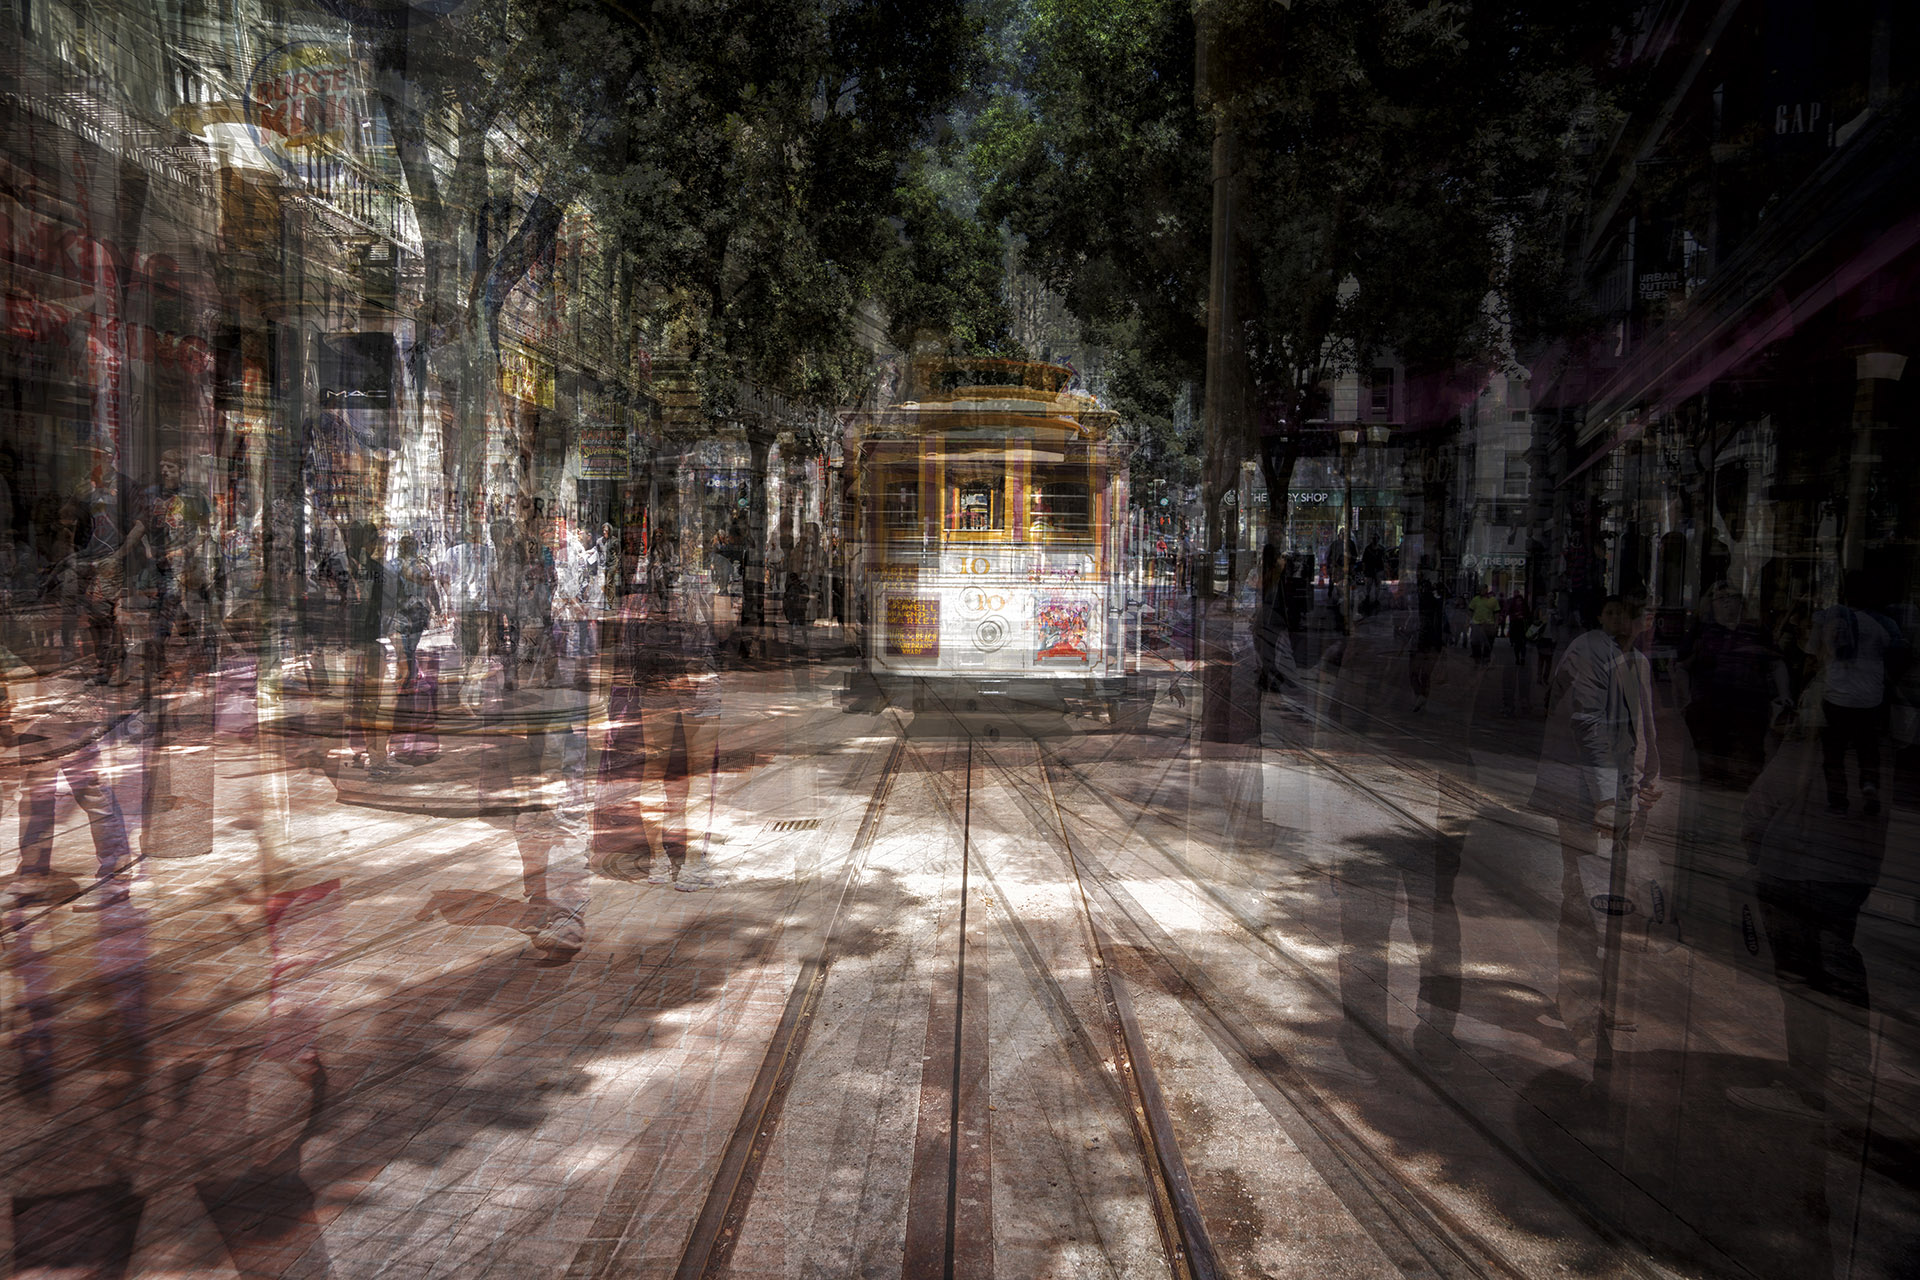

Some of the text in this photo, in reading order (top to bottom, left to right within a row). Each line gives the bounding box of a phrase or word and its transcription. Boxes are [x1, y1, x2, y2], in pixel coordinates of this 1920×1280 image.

[256, 69, 348, 106] BURGE
[1775, 102, 1822, 135] GAP
[1639, 272, 1678, 283] URBAN
[1300, 493, 1329, 503] SHOP
[959, 557, 991, 575] 10
[1483, 556, 1526, 567] THE BOD
[977, 594, 1006, 612] 10
